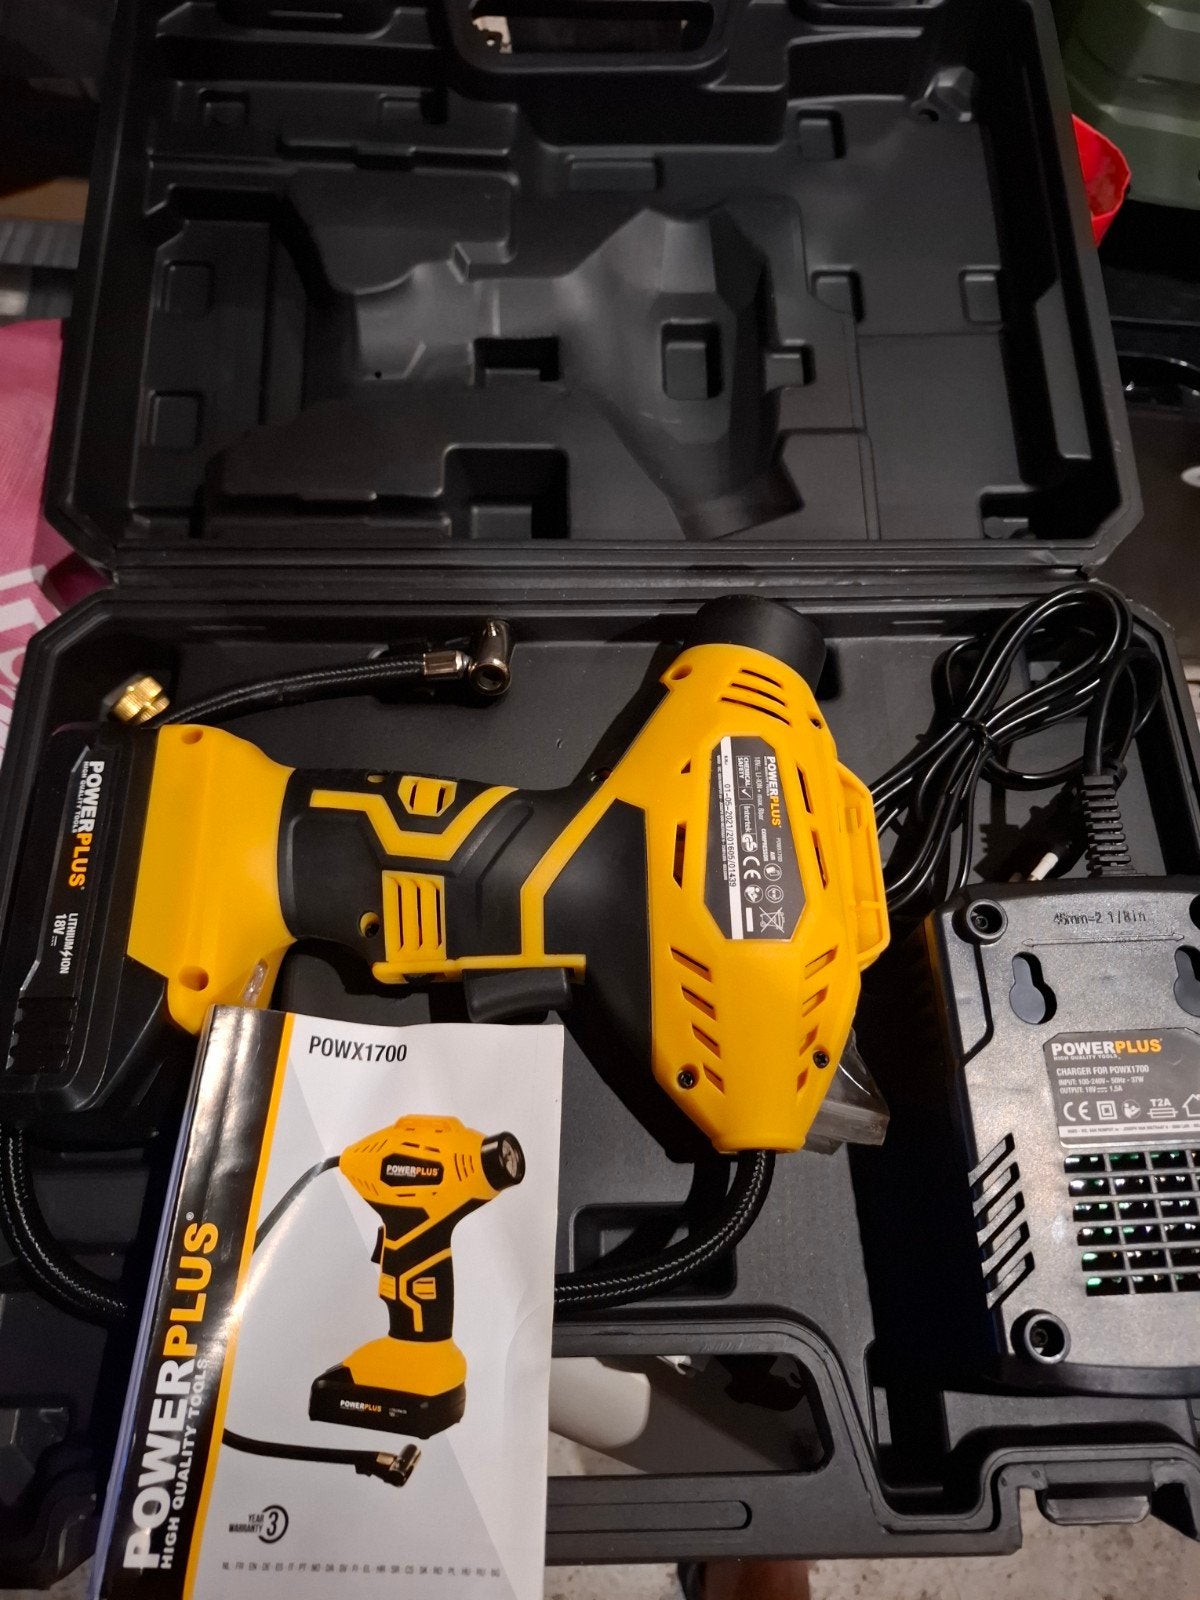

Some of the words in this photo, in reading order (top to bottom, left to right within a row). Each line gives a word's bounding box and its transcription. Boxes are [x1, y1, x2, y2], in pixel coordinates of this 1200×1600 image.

[80, 761, 89, 780] HIGH
[75, 780, 86, 809] QUALITY
[767, 756, 781, 827] POWERPLUS
[68, 761, 105, 888] POWERPLUS
[71, 809, 81, 834] TOOLS
[743, 806, 752, 832] Intertek
[761, 829, 769, 861] COMPRESSOR
[53, 914, 67, 936] 18V
[309, 1036, 407, 1062] POWX1700
[1051, 1039, 1162, 1056] POWERPLUS
[1056, 1067, 1091, 1076] CHARGER
[1093, 1066, 1108, 1075] FOR
[1109, 1065, 1149, 1074] POWX1700
[1149, 1098, 1172, 1107] T2A
[386, 1165, 438, 1176] POWERPLUS
[340, 1400, 381, 1412] POWERPLUS
[160, 1517, 180, 1569] HIGH
[173, 1425, 197, 1511] QUALITY
[188, 1359, 208, 1419] TOOLS
[229, 1524, 262, 1532] WARRANTY
[249, 1514, 264, 1522] YEAR
[267, 1511, 279, 1536] 3
